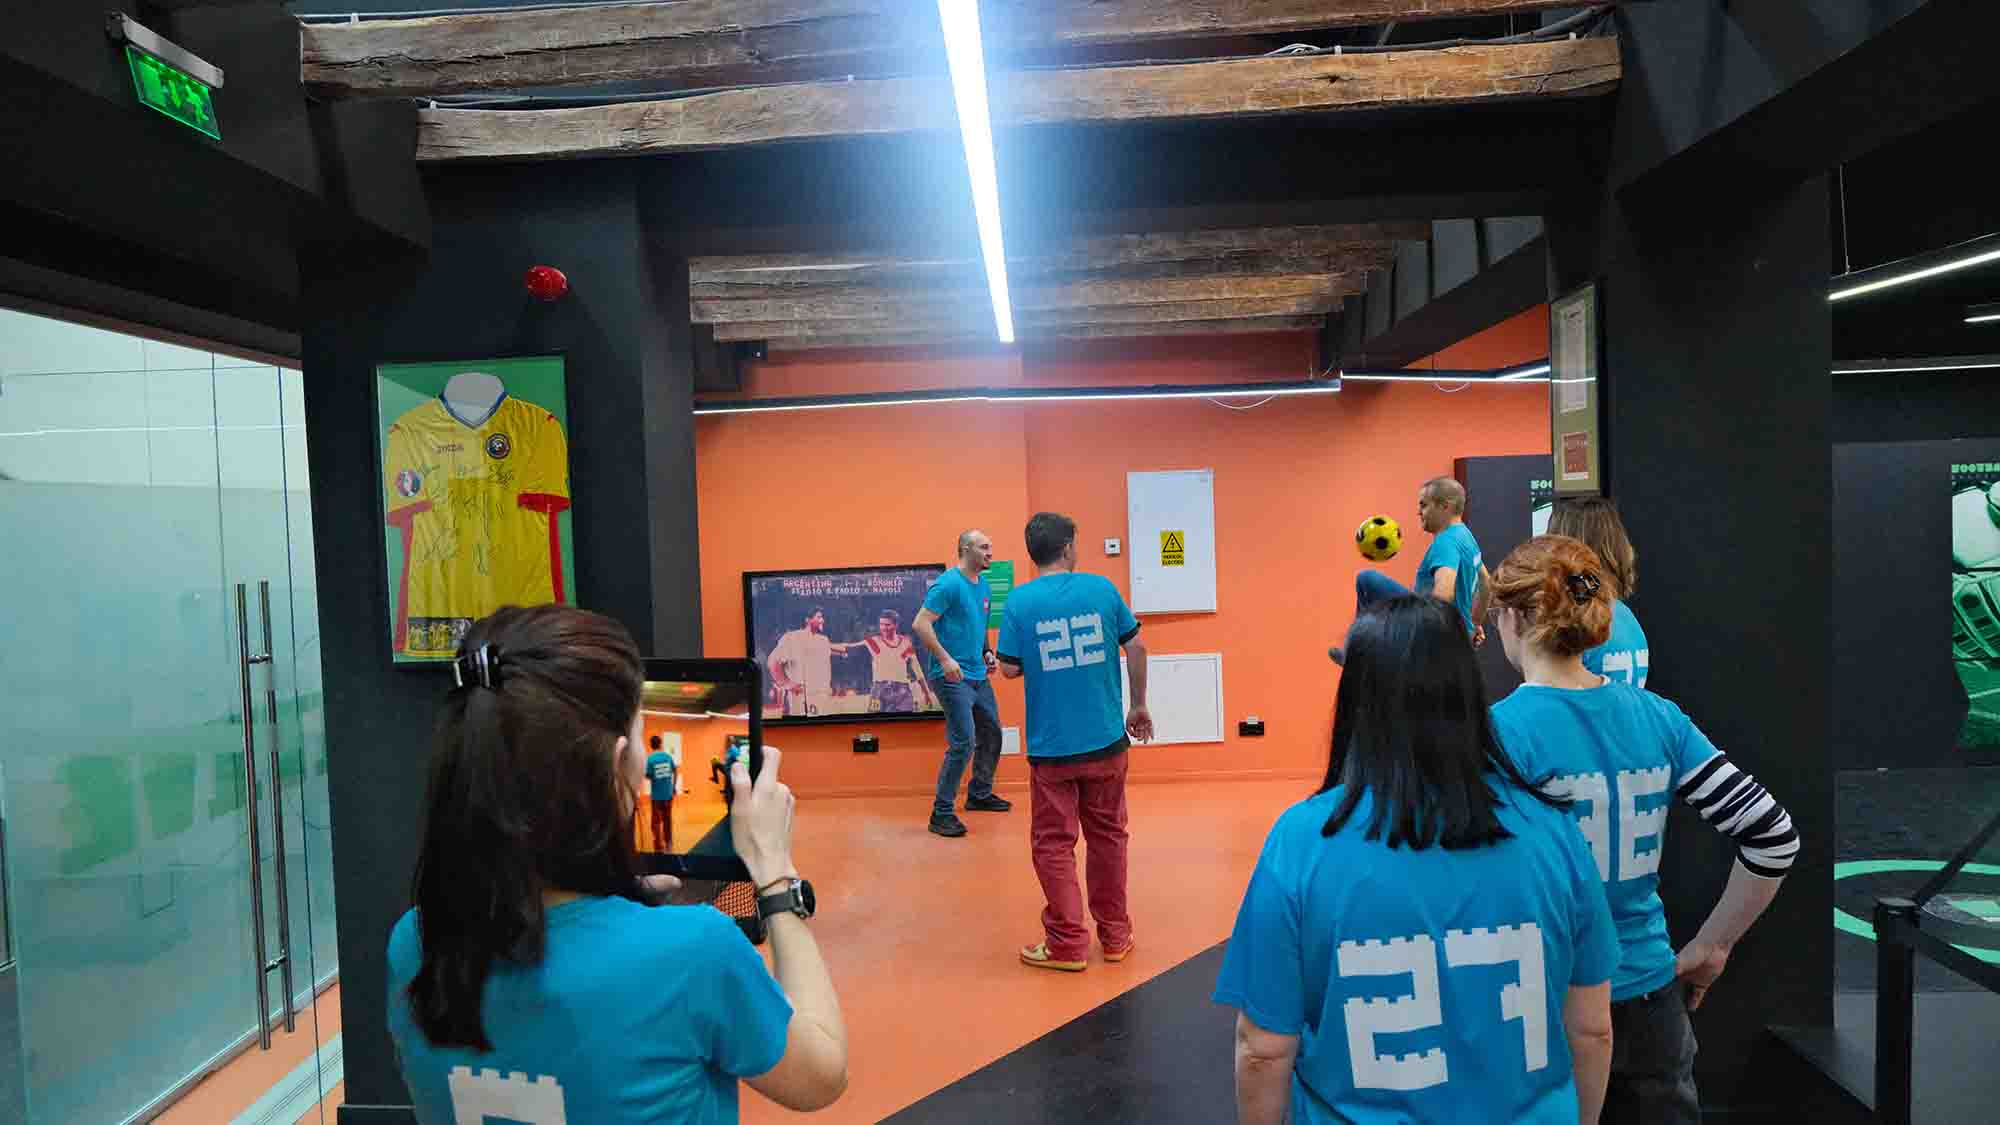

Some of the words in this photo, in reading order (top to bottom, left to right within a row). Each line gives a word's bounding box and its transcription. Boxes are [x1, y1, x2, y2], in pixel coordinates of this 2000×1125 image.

[783, 578, 832, 589] ARGENTINA
[1036, 612, 1106, 672] 22
[1337, 922, 1549, 1090] 27
